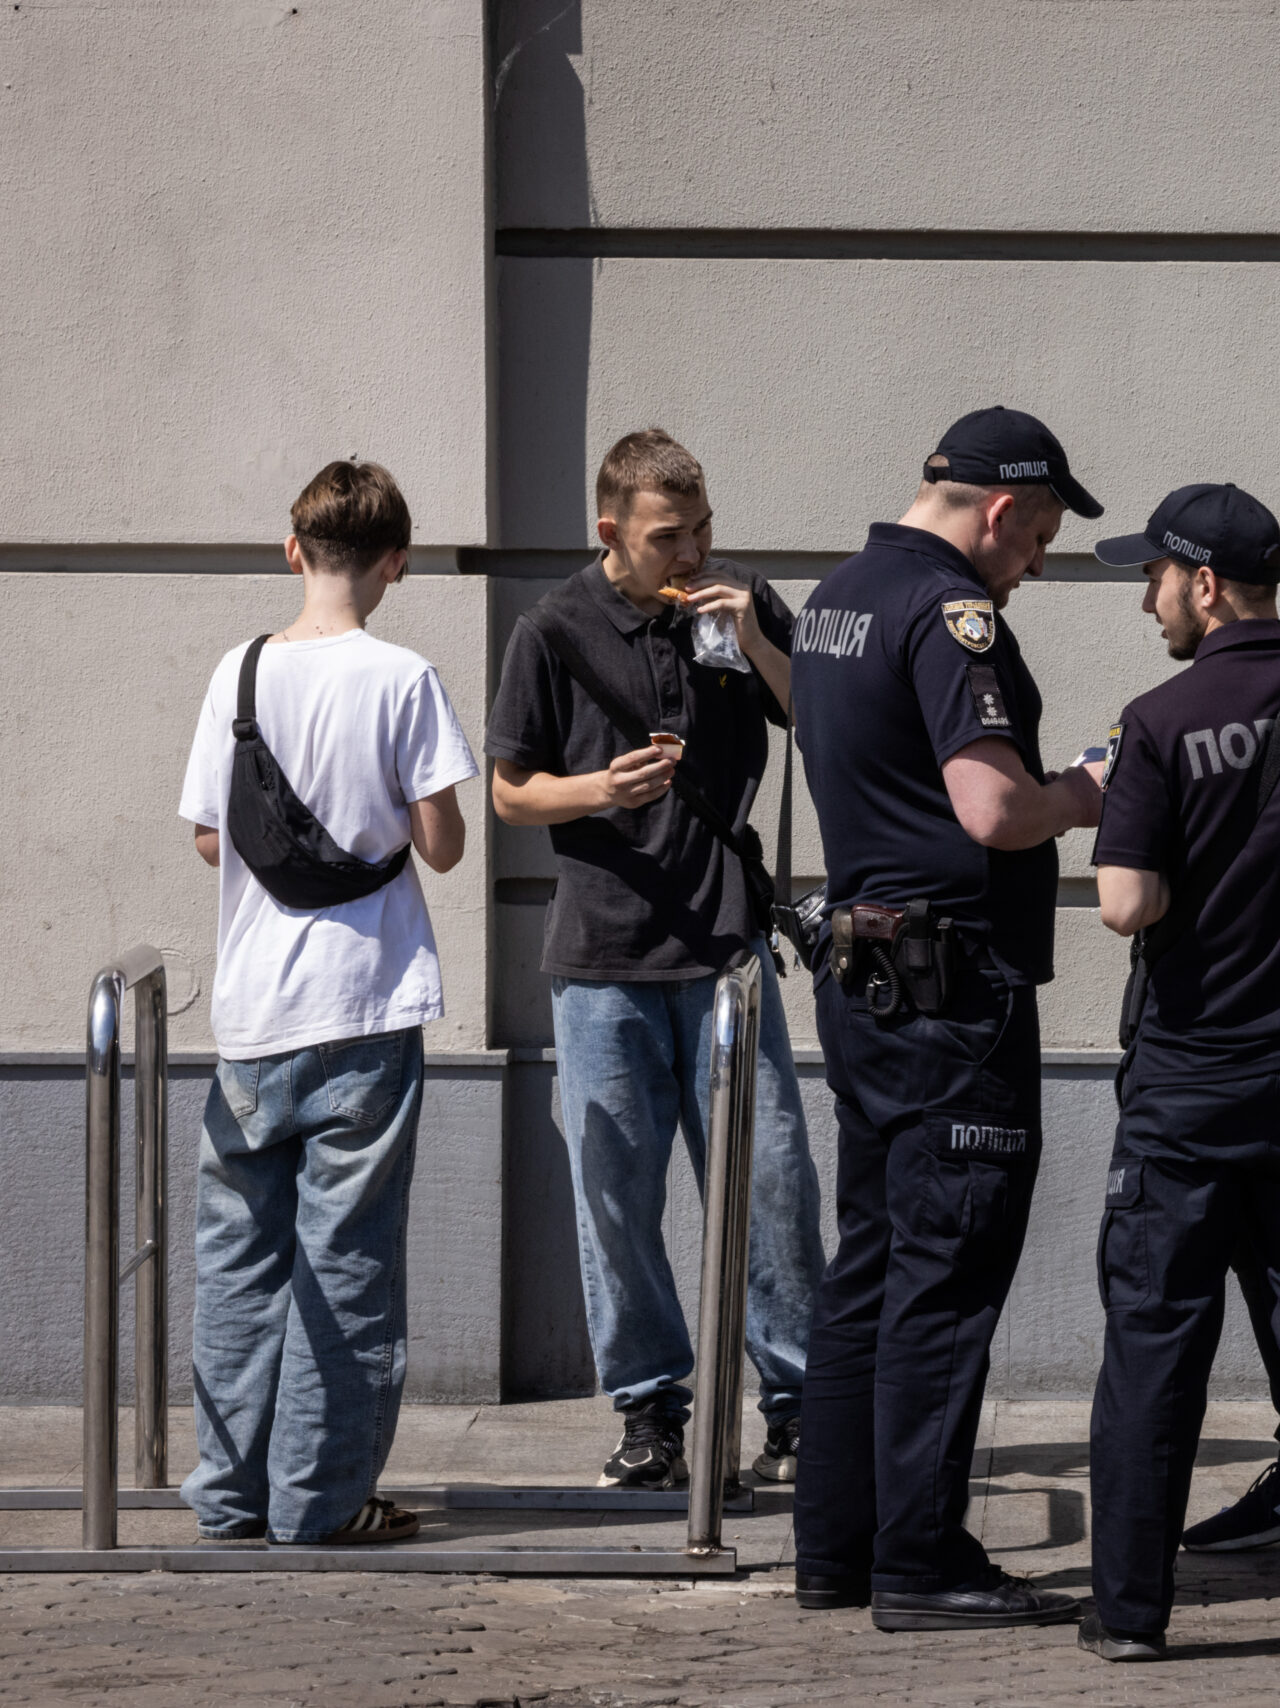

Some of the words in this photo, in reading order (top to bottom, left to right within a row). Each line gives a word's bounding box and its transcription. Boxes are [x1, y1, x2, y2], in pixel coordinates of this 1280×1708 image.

[999, 460, 1049, 480] ПОЛІЦІЯ
[1162, 530, 1213, 564] ПОЛІЦІЯ
[792, 608, 875, 659] ПОЛІЦІЯ
